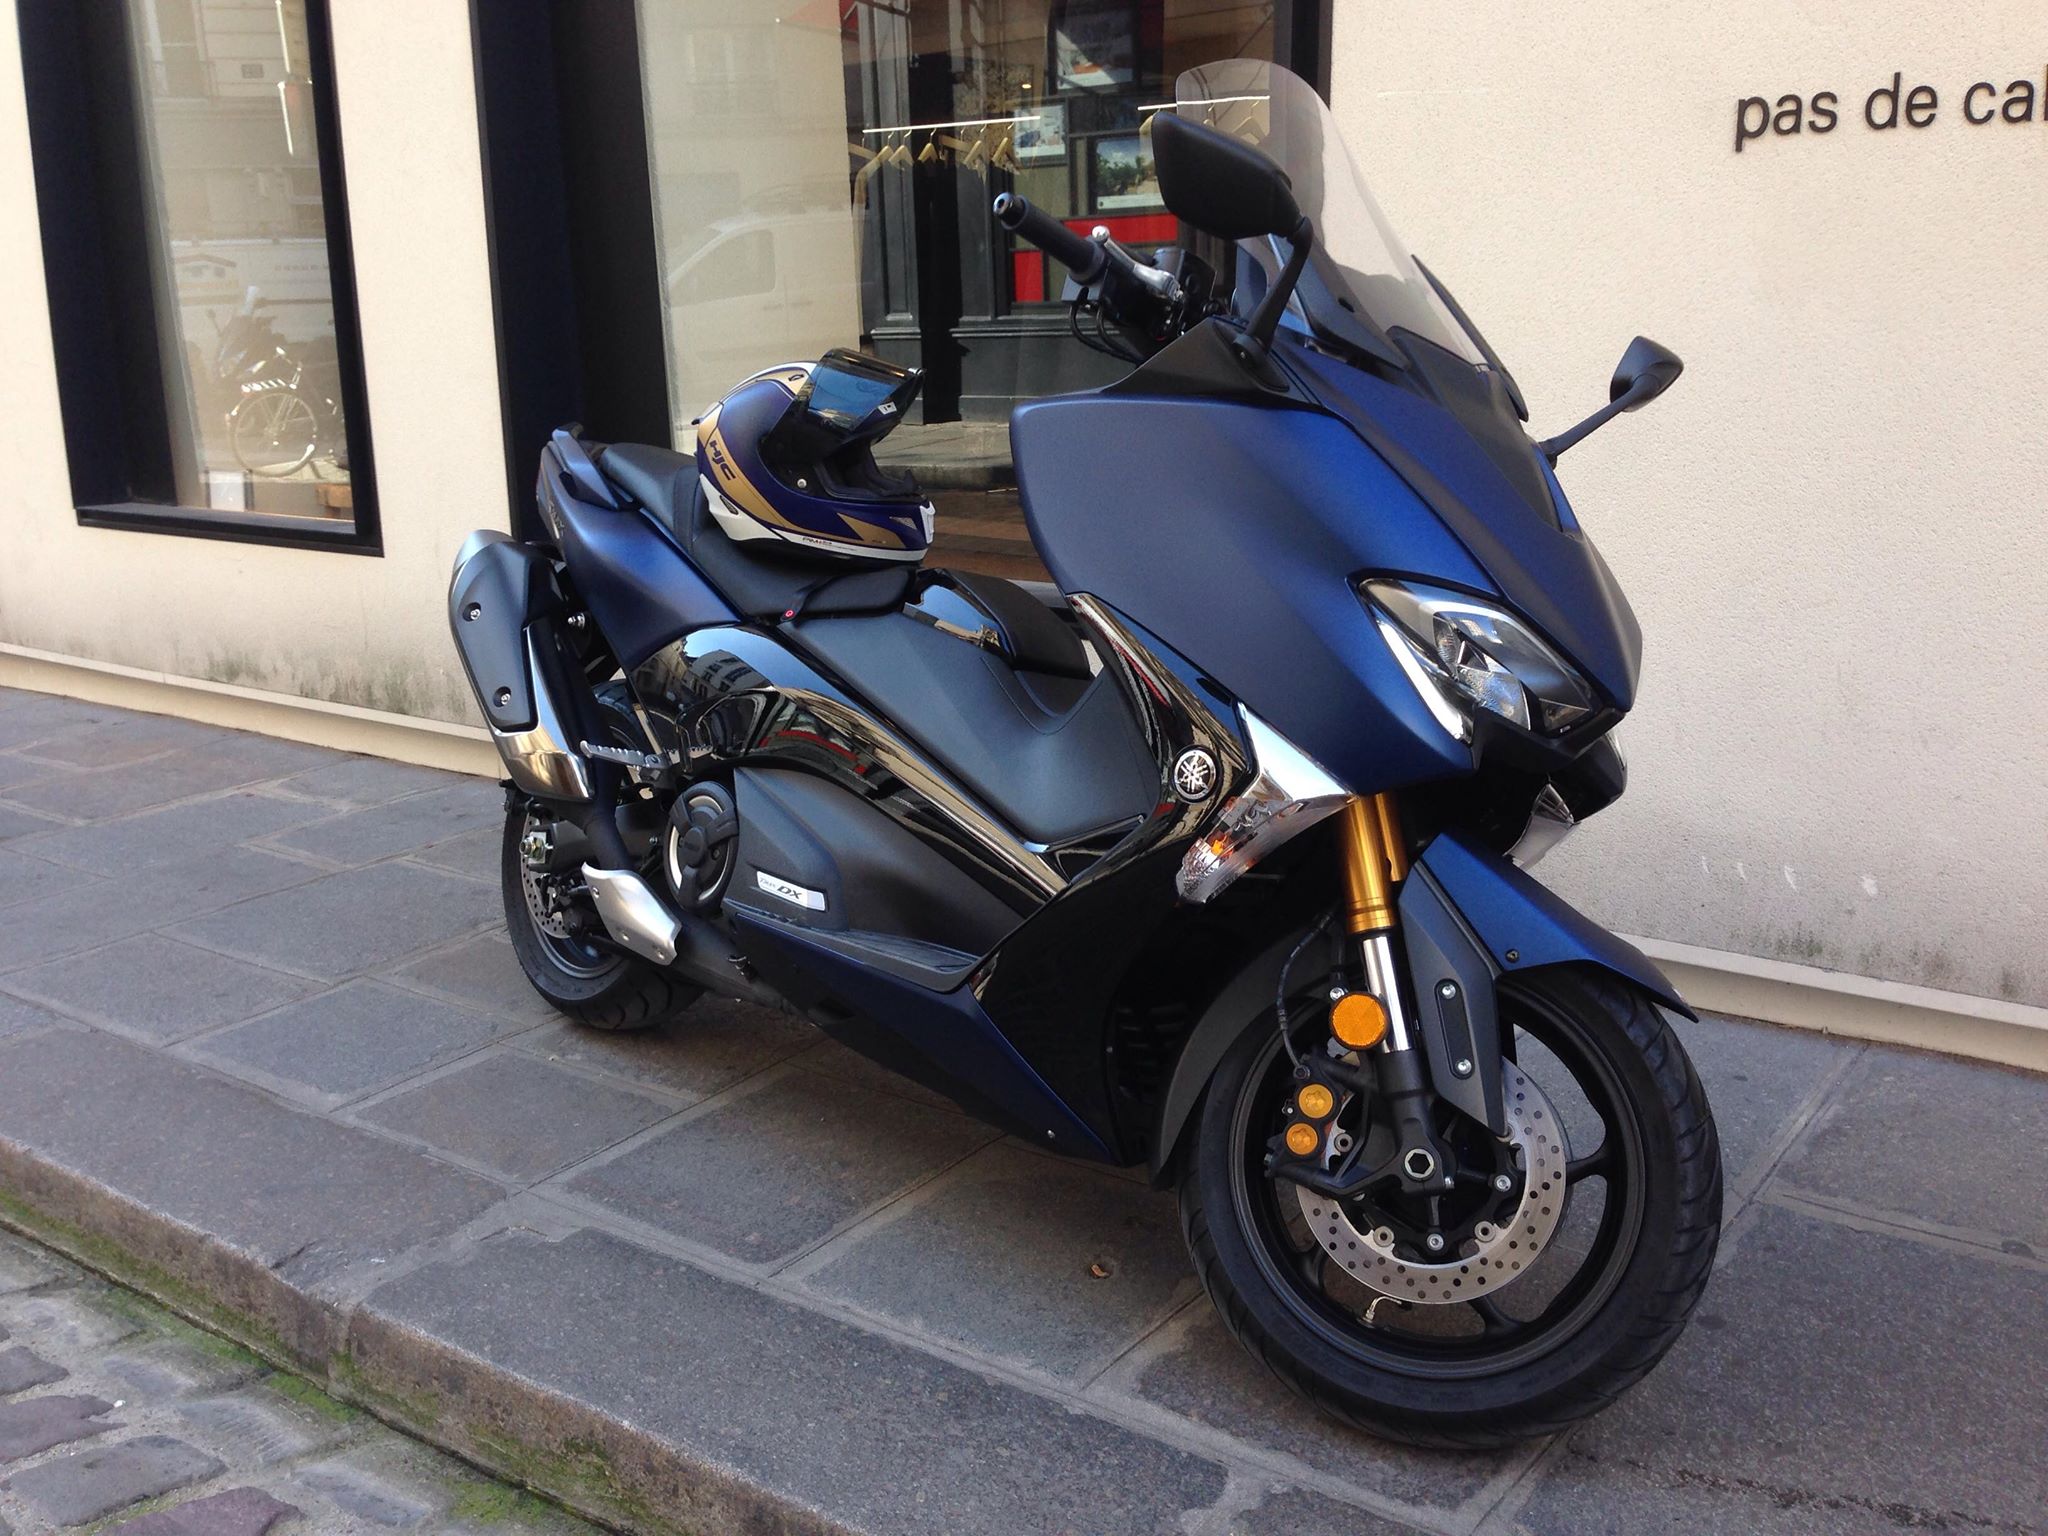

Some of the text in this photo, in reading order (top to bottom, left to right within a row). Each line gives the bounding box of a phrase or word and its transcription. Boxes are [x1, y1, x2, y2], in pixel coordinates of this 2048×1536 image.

[1735, 91, 1838, 152] pas
[1865, 71, 1938, 129] de
[709, 440, 736, 481] HJC
[777, 885, 802, 899] DX
